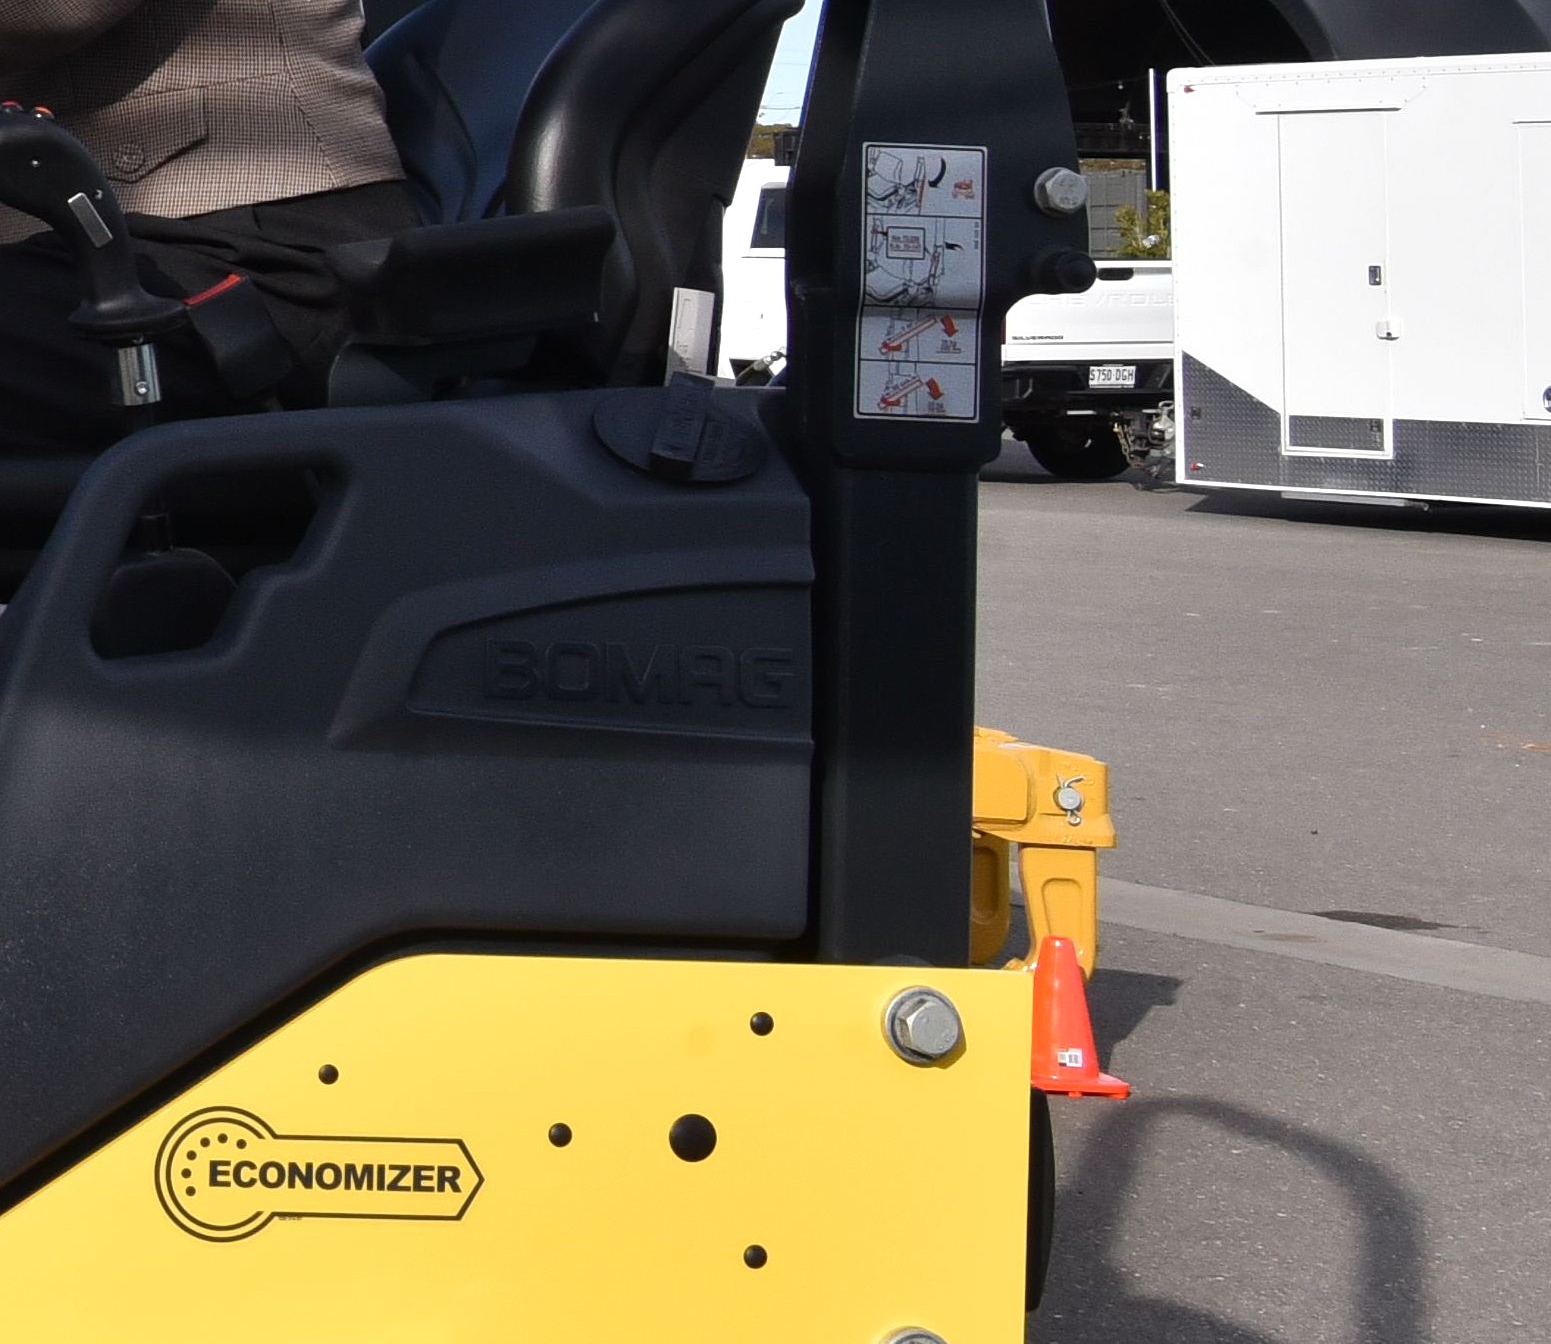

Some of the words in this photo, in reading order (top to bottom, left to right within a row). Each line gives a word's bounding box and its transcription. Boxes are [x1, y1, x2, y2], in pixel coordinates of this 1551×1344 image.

[1115, 368, 1134, 381] DGH
[484, 639, 794, 708] BOMAG
[209, 1159, 462, 1194] ECONOMIZER
